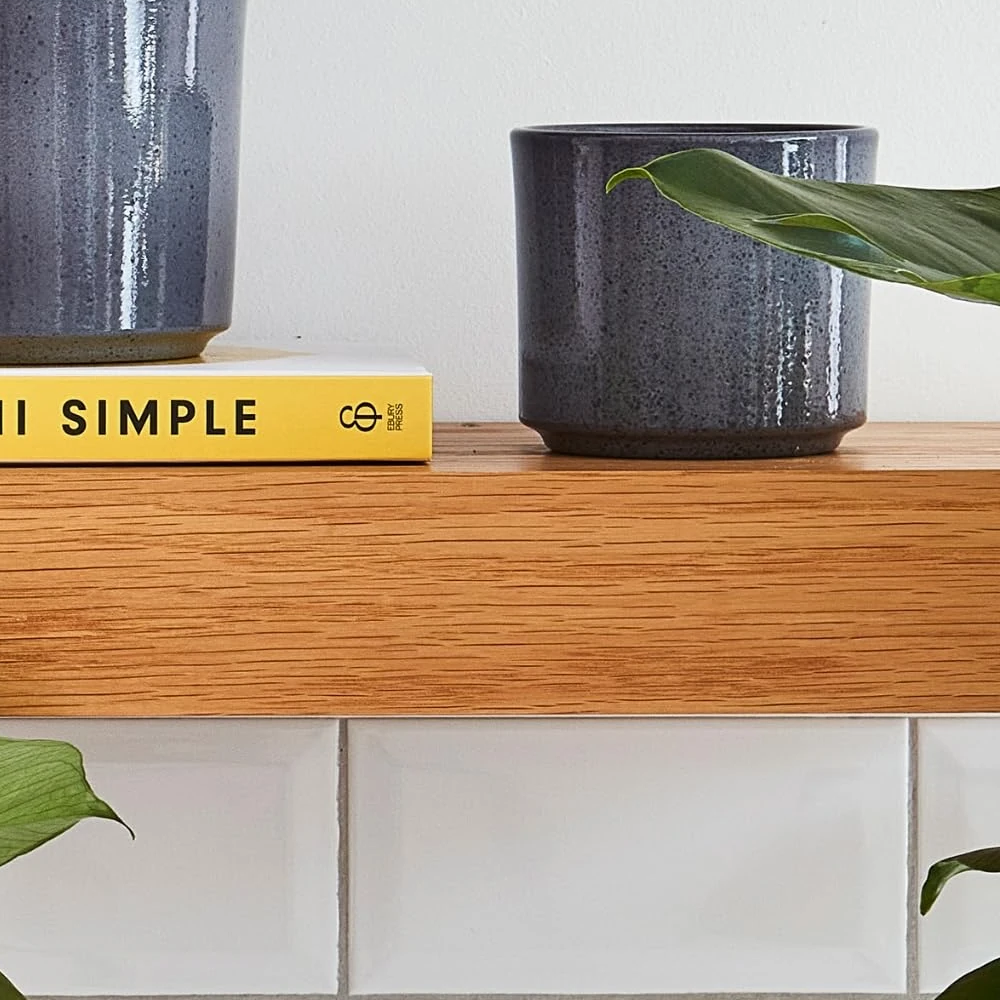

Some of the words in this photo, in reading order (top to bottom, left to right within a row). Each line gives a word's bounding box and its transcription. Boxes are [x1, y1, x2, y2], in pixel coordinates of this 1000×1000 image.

[61, 398, 257, 437] SIMPLE
[387, 403, 395, 431] EBURY
[395, 403, 403, 431] PRESS
